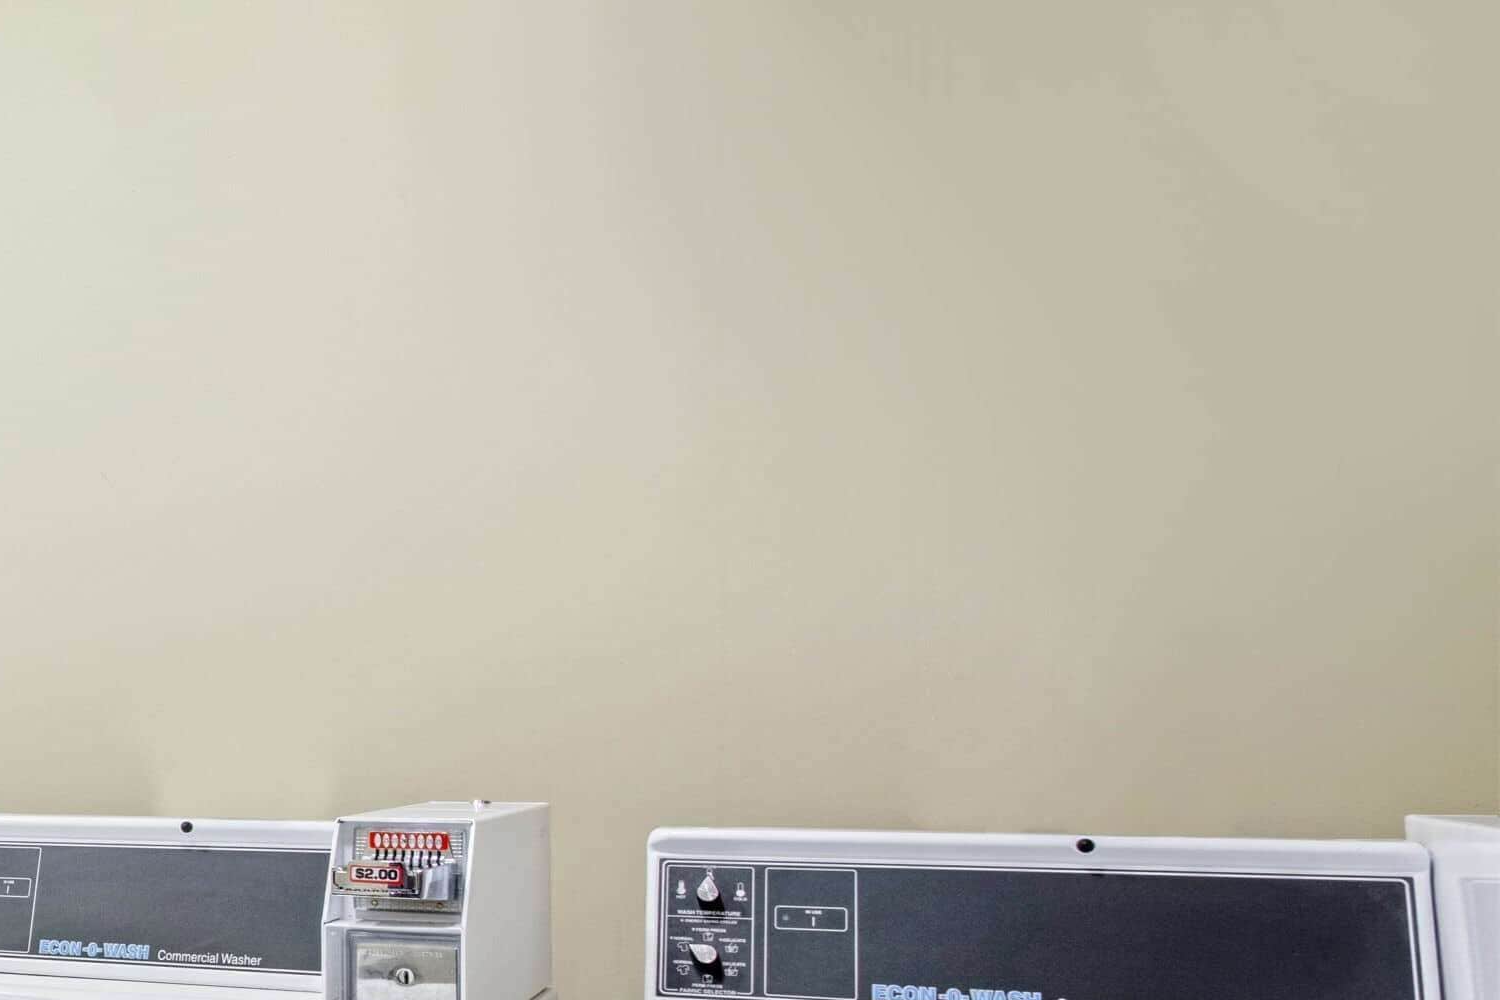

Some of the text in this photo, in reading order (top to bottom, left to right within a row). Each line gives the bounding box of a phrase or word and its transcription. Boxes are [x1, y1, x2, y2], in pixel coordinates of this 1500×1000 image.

[355, 867, 398, 881] $2.00
[157, 949, 219, 965] Commercial
[221, 952, 263, 967] Washer
